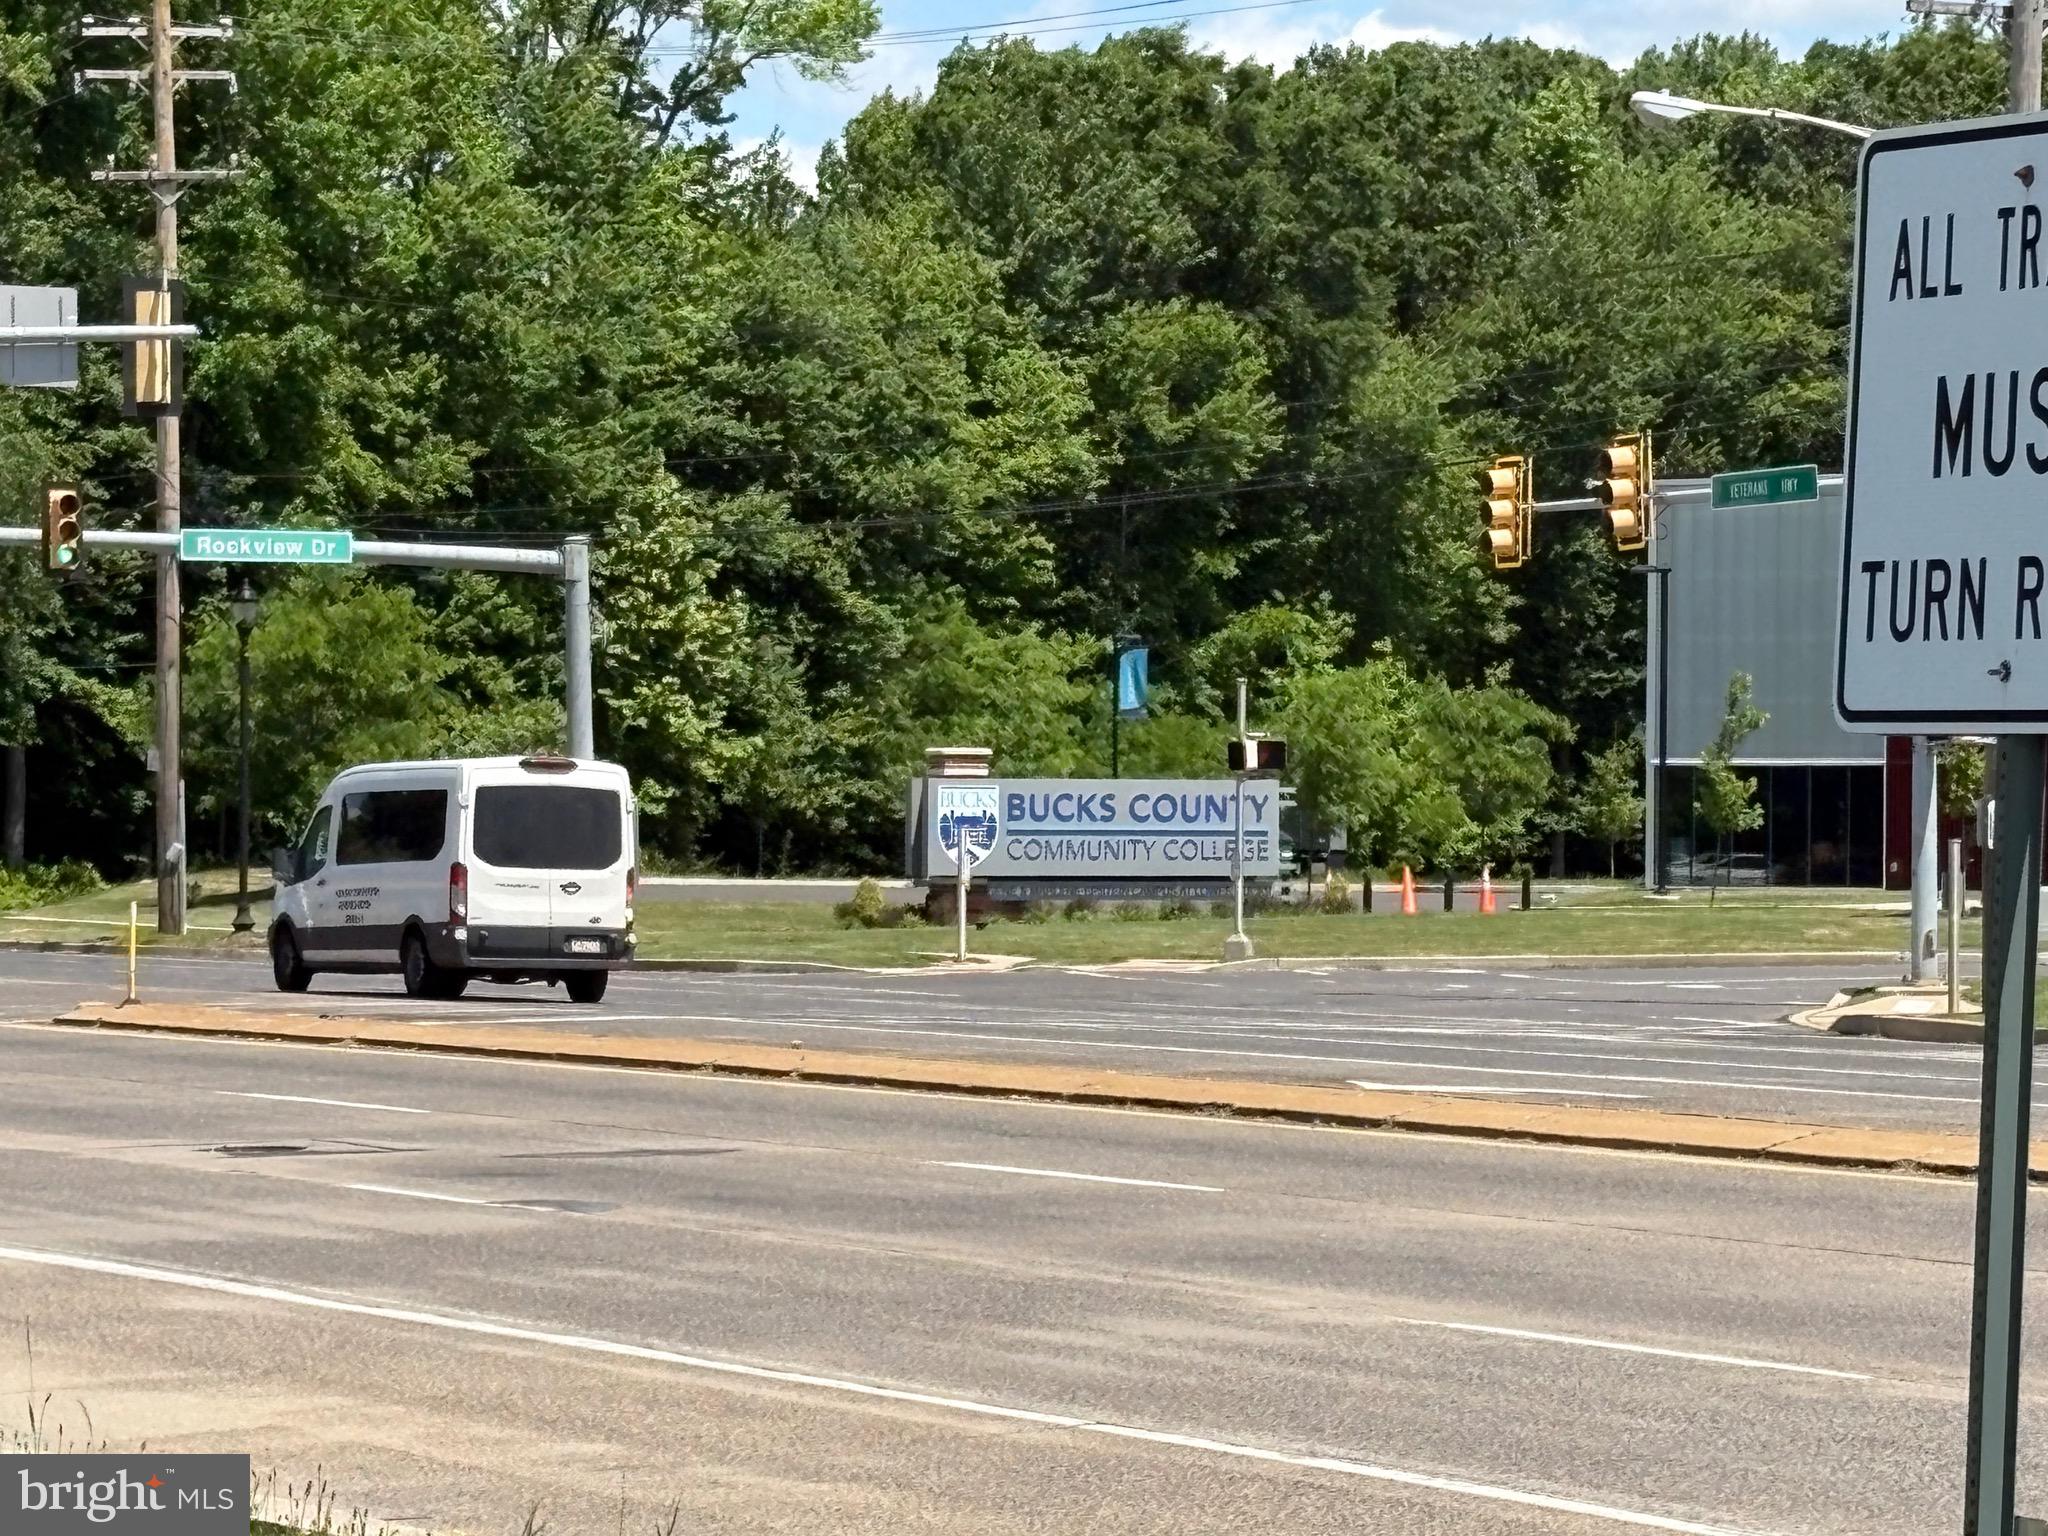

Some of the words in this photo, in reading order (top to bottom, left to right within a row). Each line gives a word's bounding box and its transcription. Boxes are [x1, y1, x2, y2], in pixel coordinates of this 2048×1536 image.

[1889, 213, 1963, 301] ALL
[1997, 205, 2048, 291] TR
[197, 536, 303, 556] Rockview
[312, 538, 337, 557] Dr
[1861, 558, 1987, 643] TURN
[940, 791, 998, 808] BUCKS
[1006, 793, 1117, 823] BUCKS
[1006, 838, 1157, 862] COMMUNITY
[1163, 838, 1269, 862] COLLEGE
